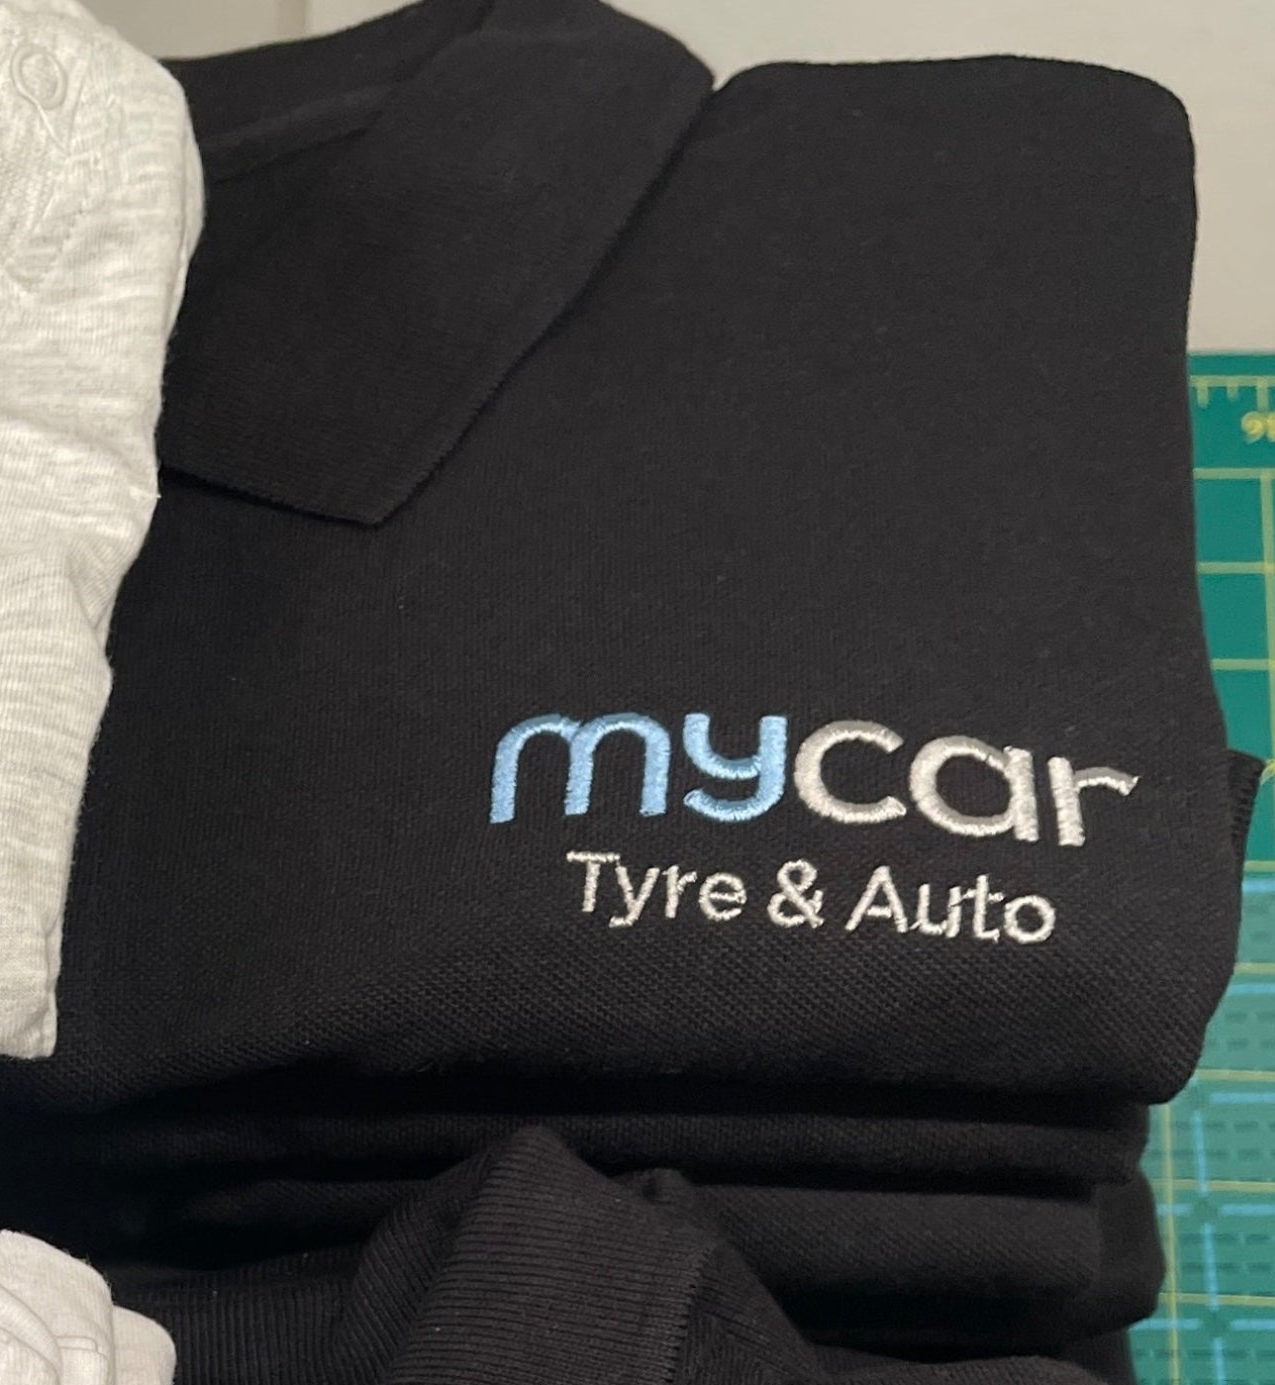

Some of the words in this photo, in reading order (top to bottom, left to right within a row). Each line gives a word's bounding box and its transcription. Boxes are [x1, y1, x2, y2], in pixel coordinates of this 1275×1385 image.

[489, 711, 1139, 847] mycar
[566, 850, 747, 929] Tyre
[766, 859, 825, 930] &
[844, 864, 1058, 944] Auto
